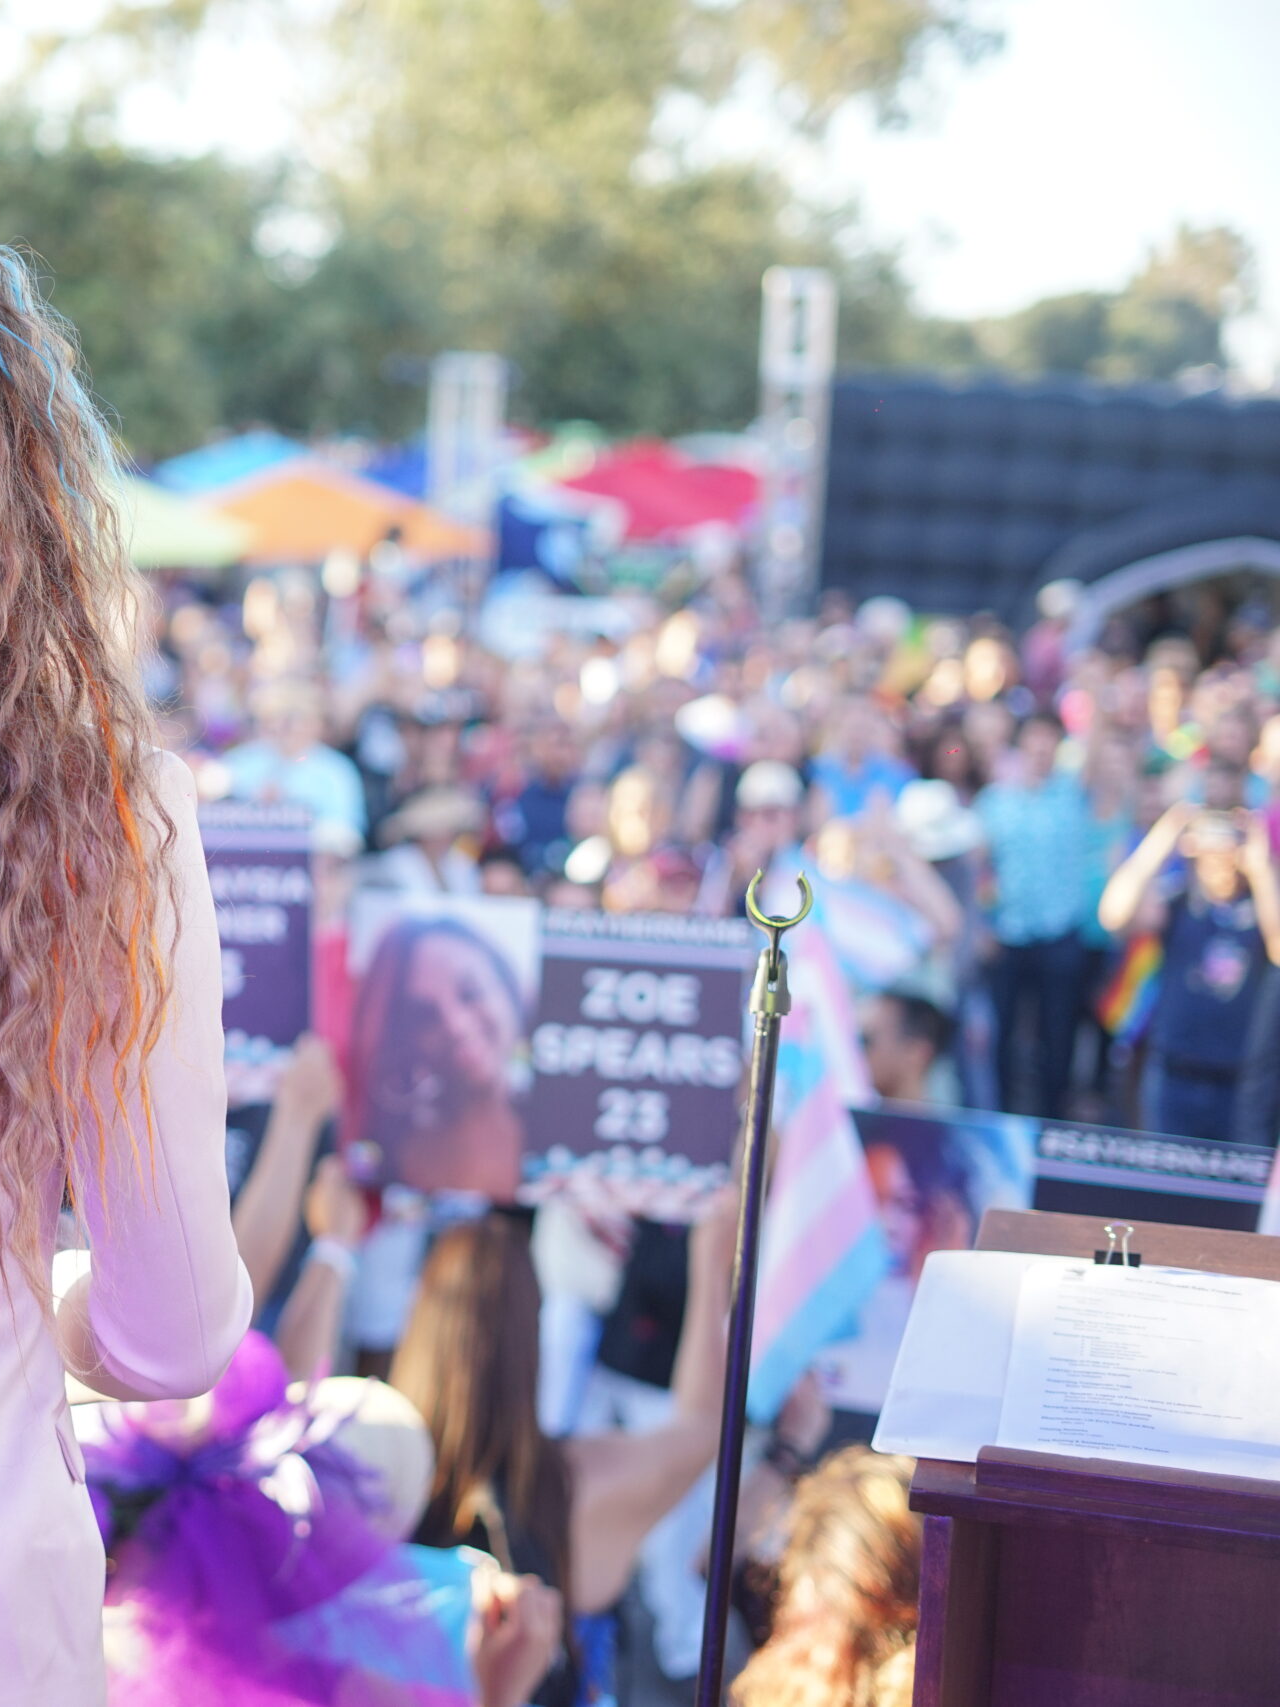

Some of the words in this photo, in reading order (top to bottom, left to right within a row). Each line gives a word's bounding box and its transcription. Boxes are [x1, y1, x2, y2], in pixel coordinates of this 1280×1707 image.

[579, 966, 702, 1027] ZOE
[531, 1021, 743, 1090] SPEARS
[593, 1087, 671, 1144] 23
